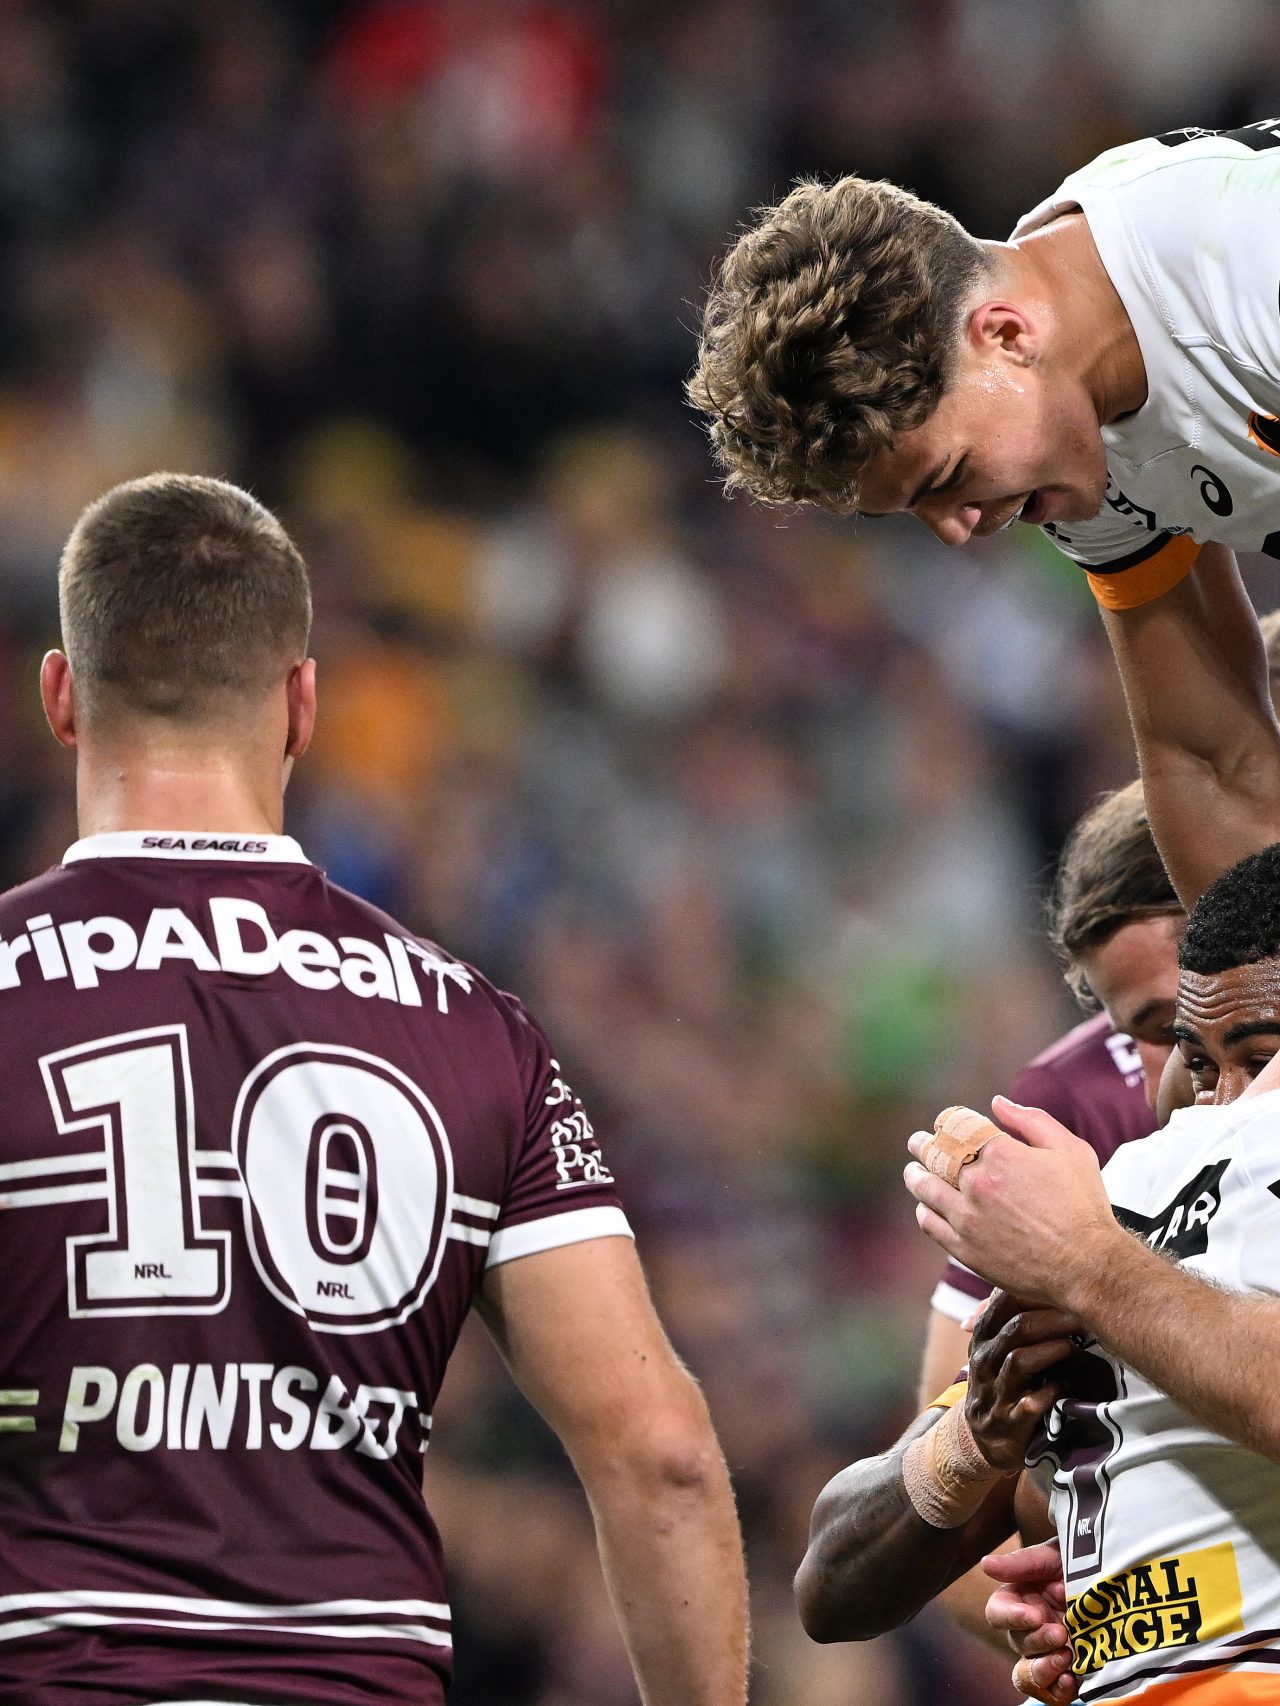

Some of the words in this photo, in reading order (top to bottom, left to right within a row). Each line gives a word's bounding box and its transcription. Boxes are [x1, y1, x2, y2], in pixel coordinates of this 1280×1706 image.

[141, 837, 186, 850] SEA
[191, 839, 268, 853] EAGLES
[0, 897, 422, 1007] ripADeal
[38, 1023, 455, 1335] 10
[1146, 1191, 1217, 1250] TAR
[134, 1264, 172, 1279] NRL
[316, 1281, 355, 1300] NRL
